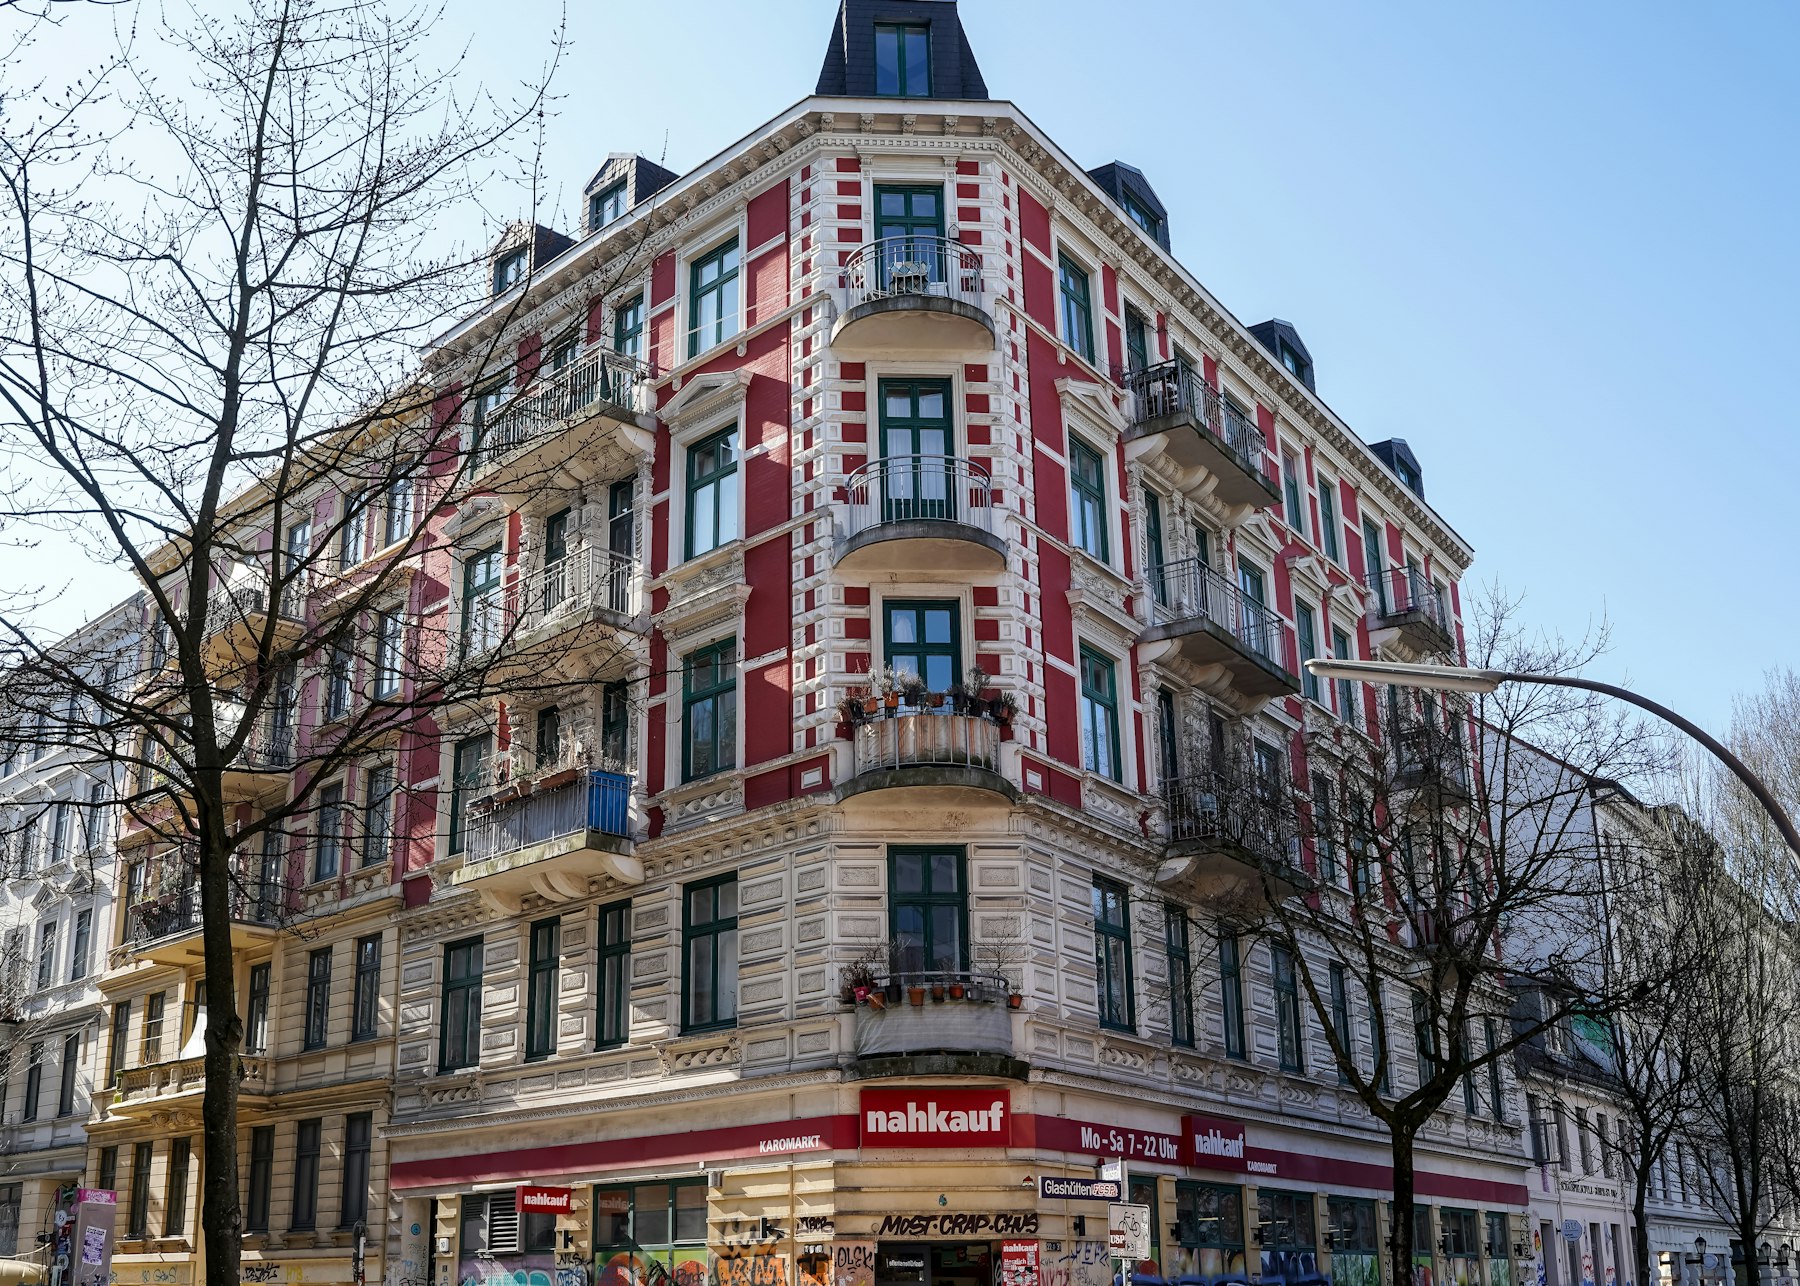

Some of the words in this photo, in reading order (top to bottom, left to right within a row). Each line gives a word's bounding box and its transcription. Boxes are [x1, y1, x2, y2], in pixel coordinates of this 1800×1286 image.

[866, 1101, 1004, 1132] nahkauf
[759, 1134, 821, 1153] KAROMARKT
[1159, 1137, 1178, 1160] Uhr
[1194, 1128, 1244, 1159] nahkauf
[1247, 1160, 1278, 1174] KAROMARKT
[1044, 1179, 1093, 1196] Glashütten
[523, 1192, 569, 1207] nahkauf
[1003, 1243, 1038, 1252] nahkauf
[1110, 1234, 1125, 1245] USP
